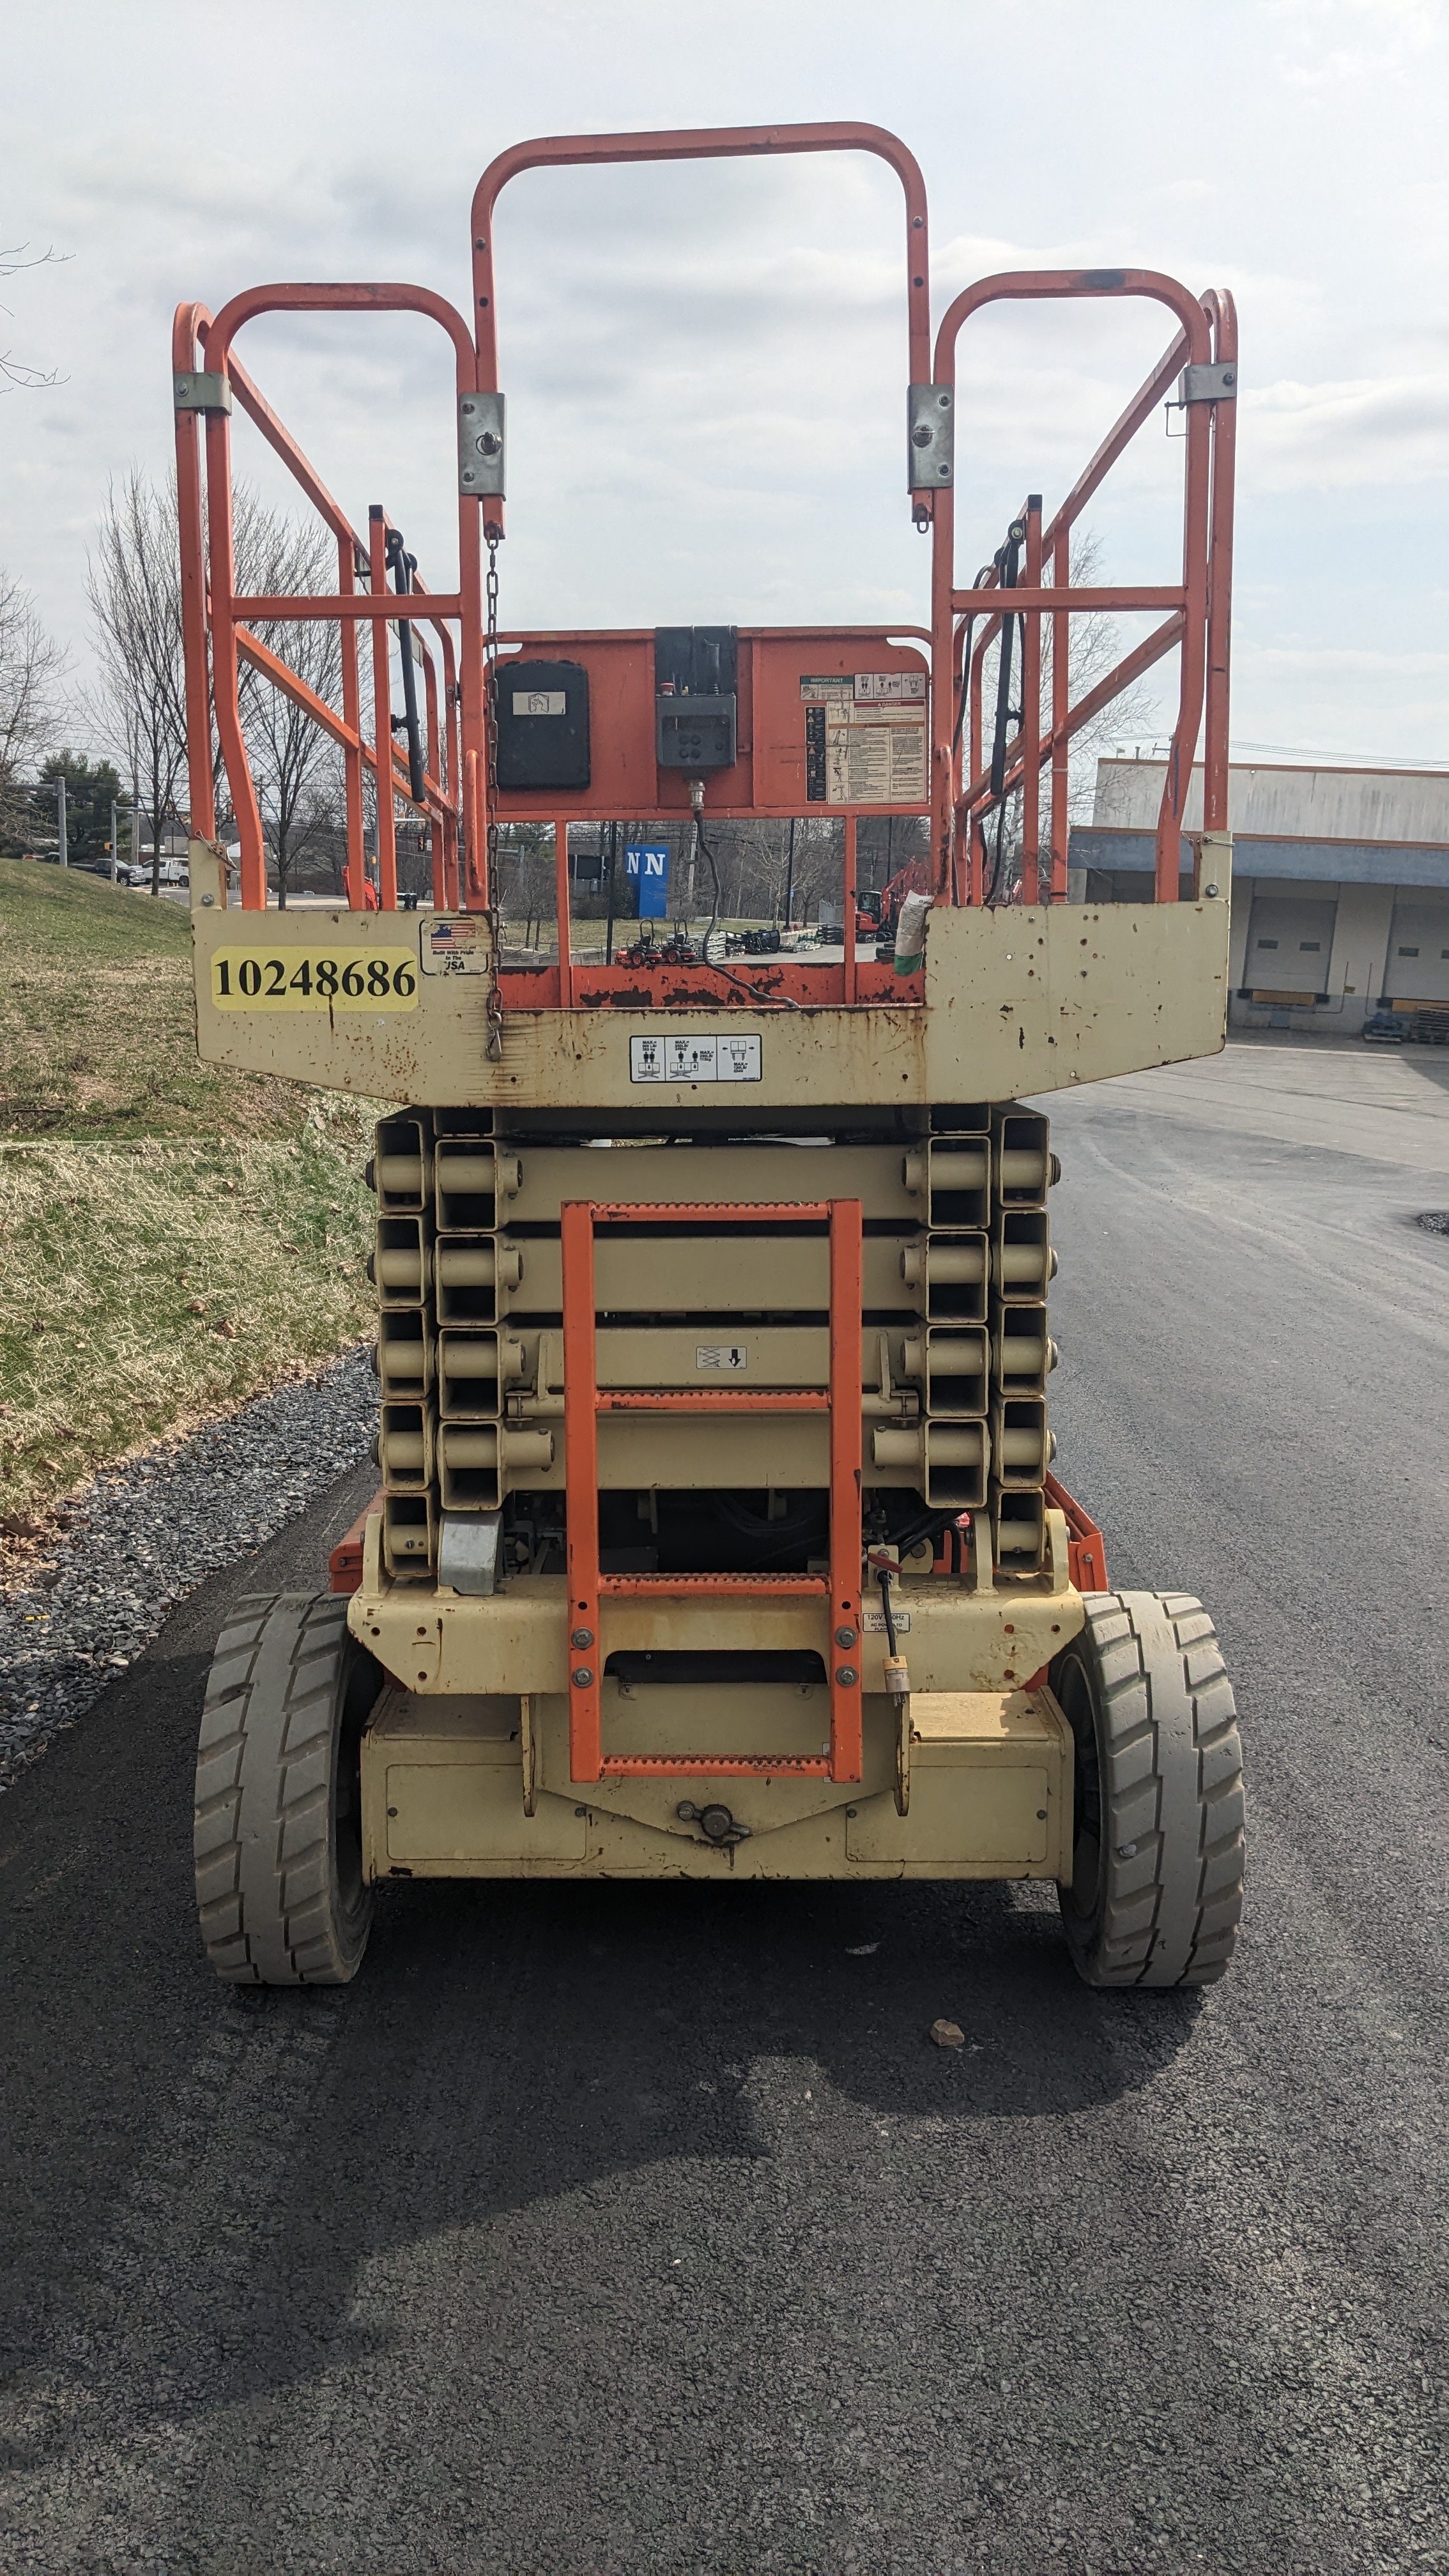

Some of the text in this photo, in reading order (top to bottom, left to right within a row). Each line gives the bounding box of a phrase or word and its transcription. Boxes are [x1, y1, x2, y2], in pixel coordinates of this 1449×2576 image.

[627, 852, 641, 874] N
[645, 853, 666, 876] N
[214, 959, 416, 997] 10248686
